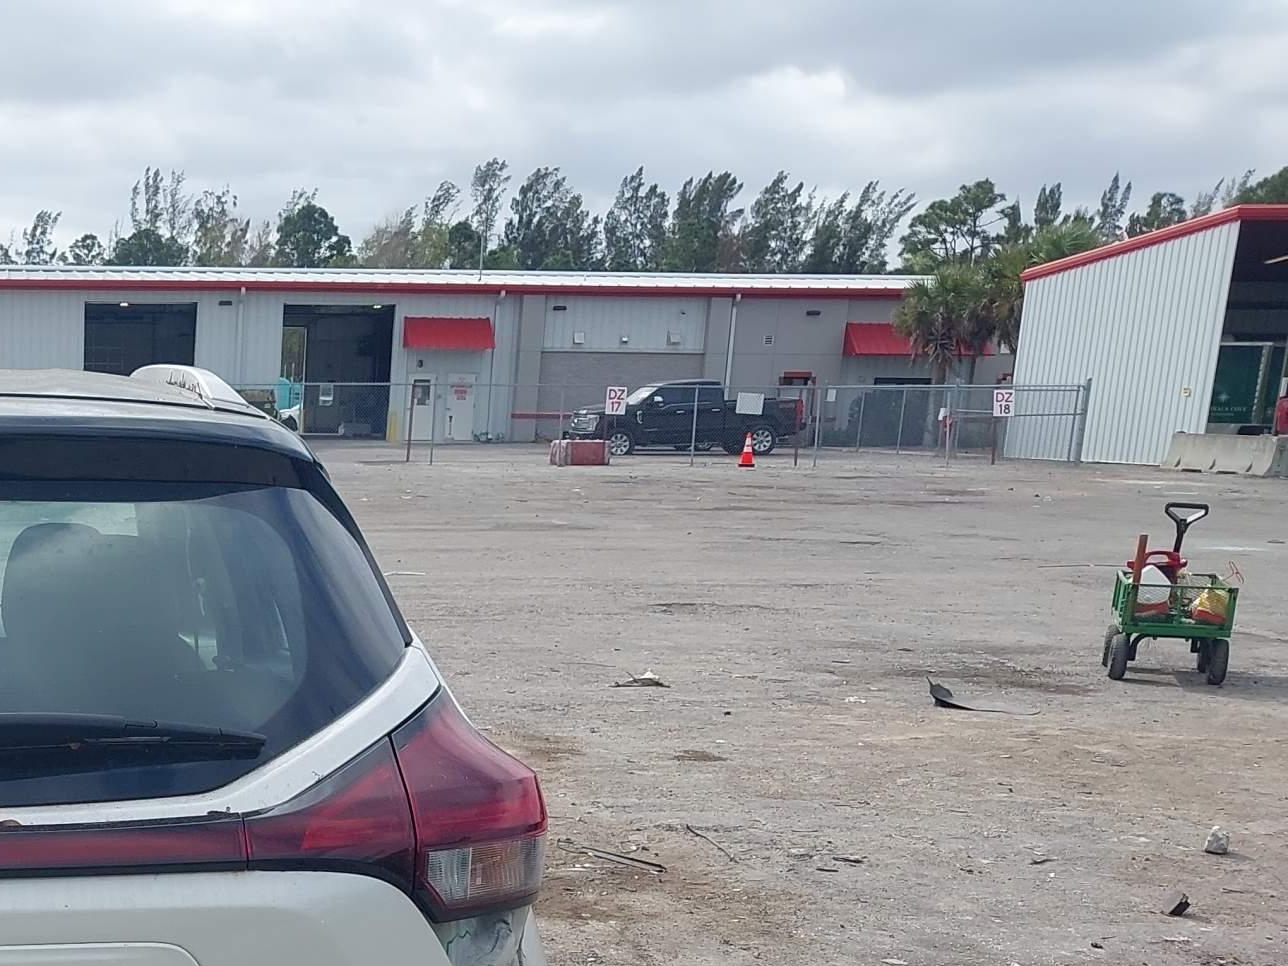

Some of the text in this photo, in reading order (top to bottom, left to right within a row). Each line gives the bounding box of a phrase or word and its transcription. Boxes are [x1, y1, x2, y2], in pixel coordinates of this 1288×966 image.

[608, 389, 626, 400] DZ
[995, 392, 1013, 403] DZ
[611, 401, 622, 412] 17
[999, 404, 1011, 415] 18
